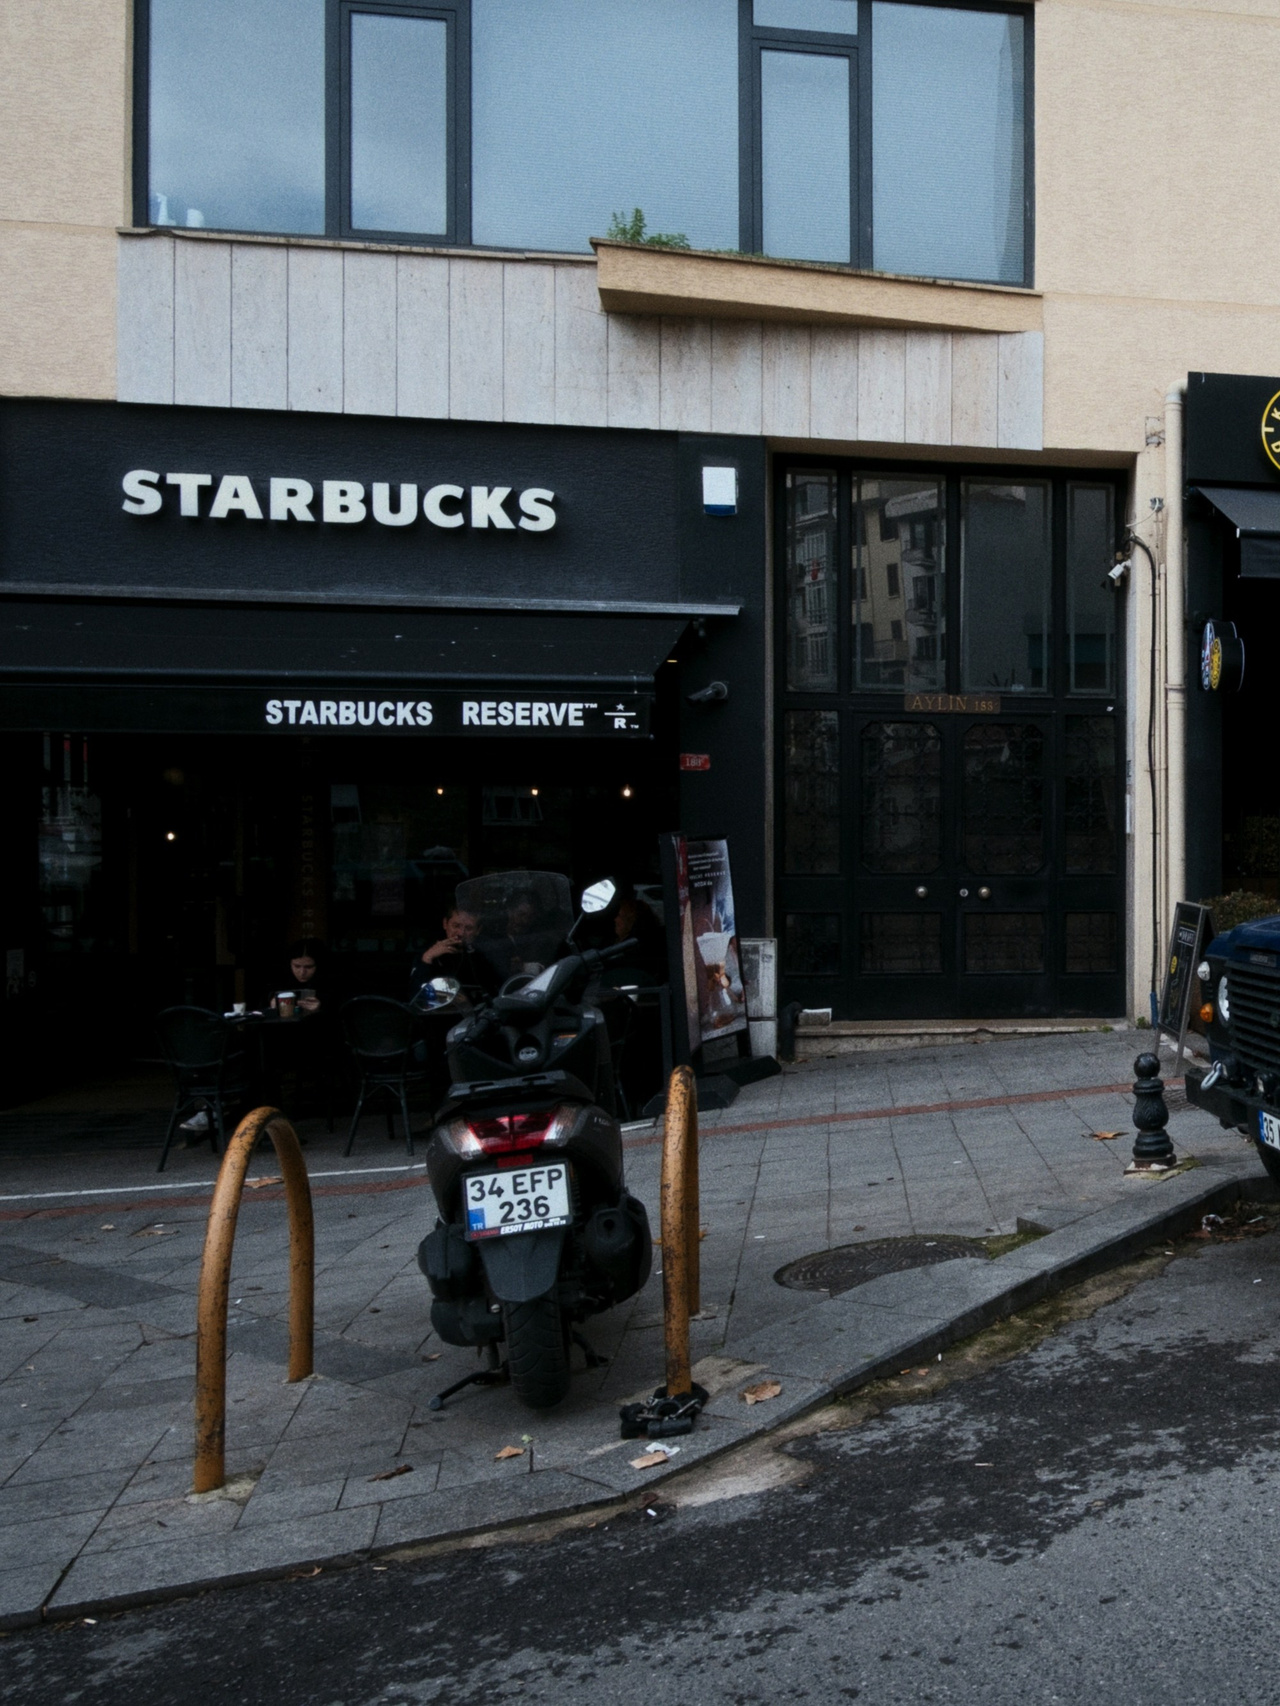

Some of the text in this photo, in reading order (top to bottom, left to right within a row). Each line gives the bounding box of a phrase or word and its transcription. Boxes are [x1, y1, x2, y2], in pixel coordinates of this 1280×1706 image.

[121, 469, 557, 532] STARBUCKS
[265, 699, 433, 727] STARBUCKS
[301, 794, 315, 897] STARBUCKS
[1263, 1116, 1275, 1145] 35
[470, 1168, 563, 1202] 34 EFP
[498, 1195, 551, 1224] 236
[471, 1222, 484, 1231] TR
[500, 1223, 523, 1235] ERSOY
[523, 1220, 543, 1231] MOTO
